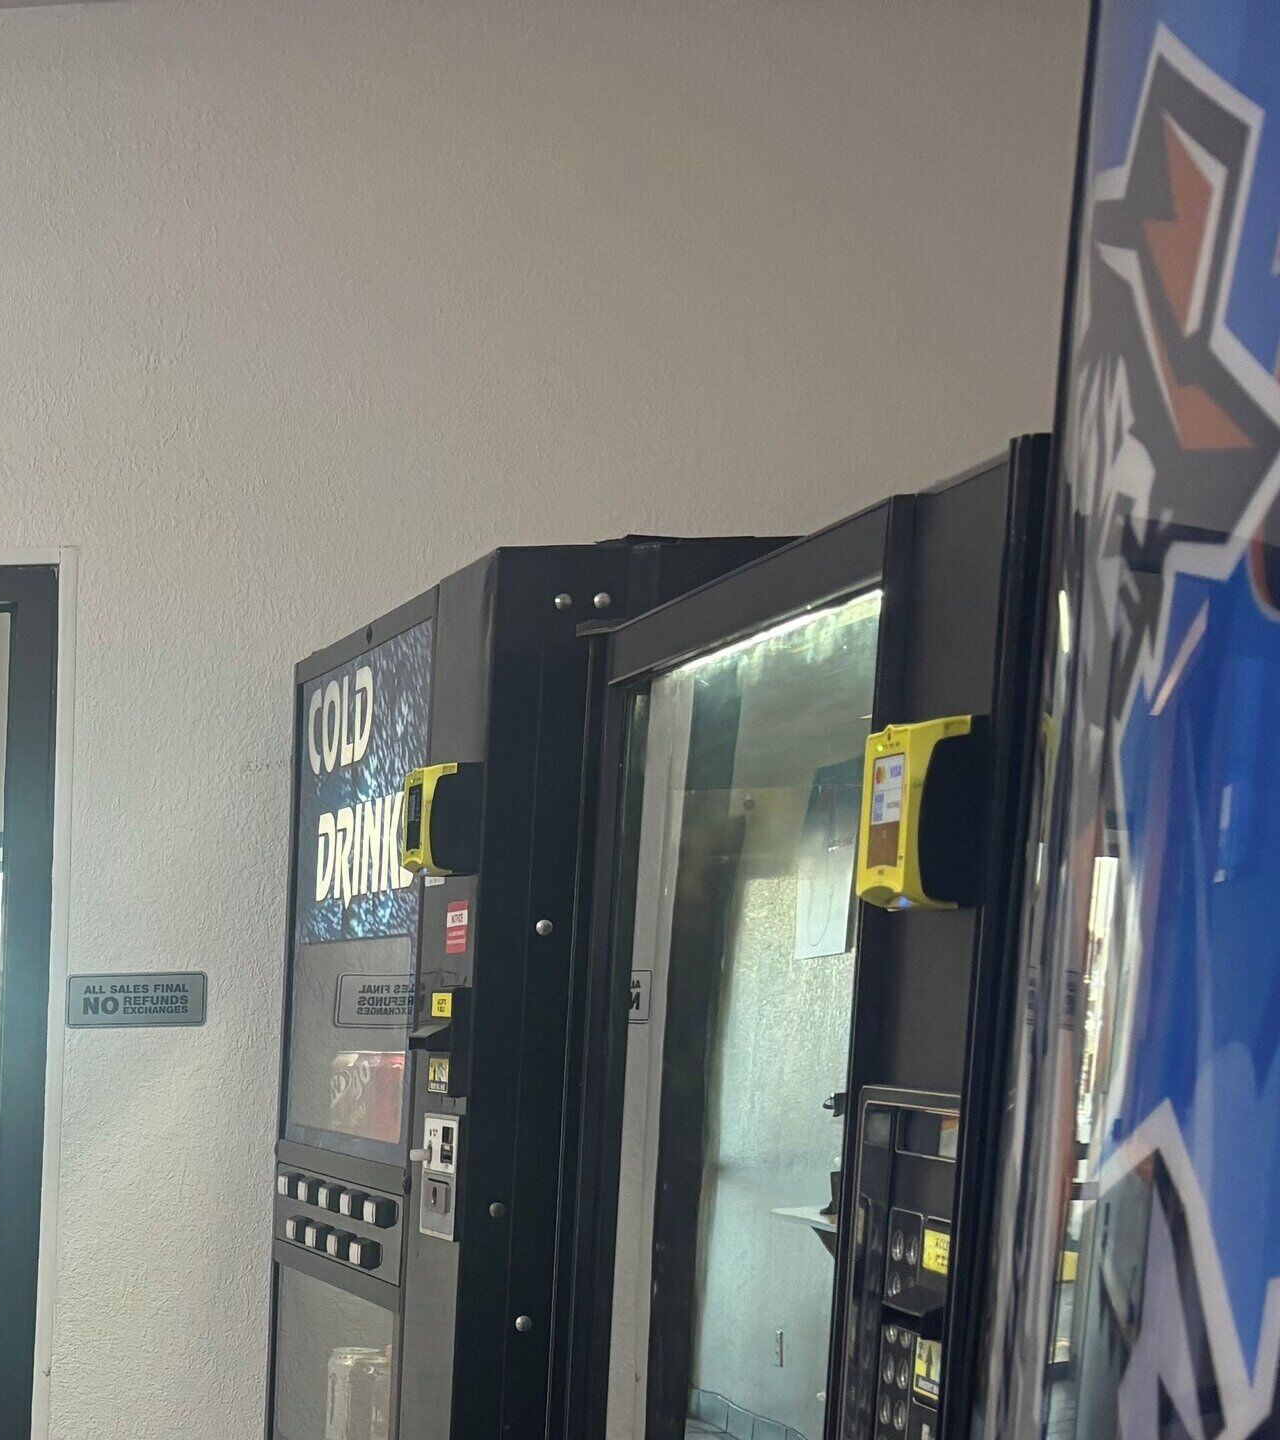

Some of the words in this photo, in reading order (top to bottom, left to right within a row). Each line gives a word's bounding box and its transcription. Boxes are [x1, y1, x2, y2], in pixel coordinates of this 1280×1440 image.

[308, 665, 374, 775] COLD
[83, 985, 106, 995] ALL
[110, 984, 149, 994] SALES
[153, 983, 189, 993] FINAL
[82, 996, 120, 1015] NO
[123, 995, 188, 1006] REFUNDS
[123, 1005, 188, 1015] EXCHANGES
